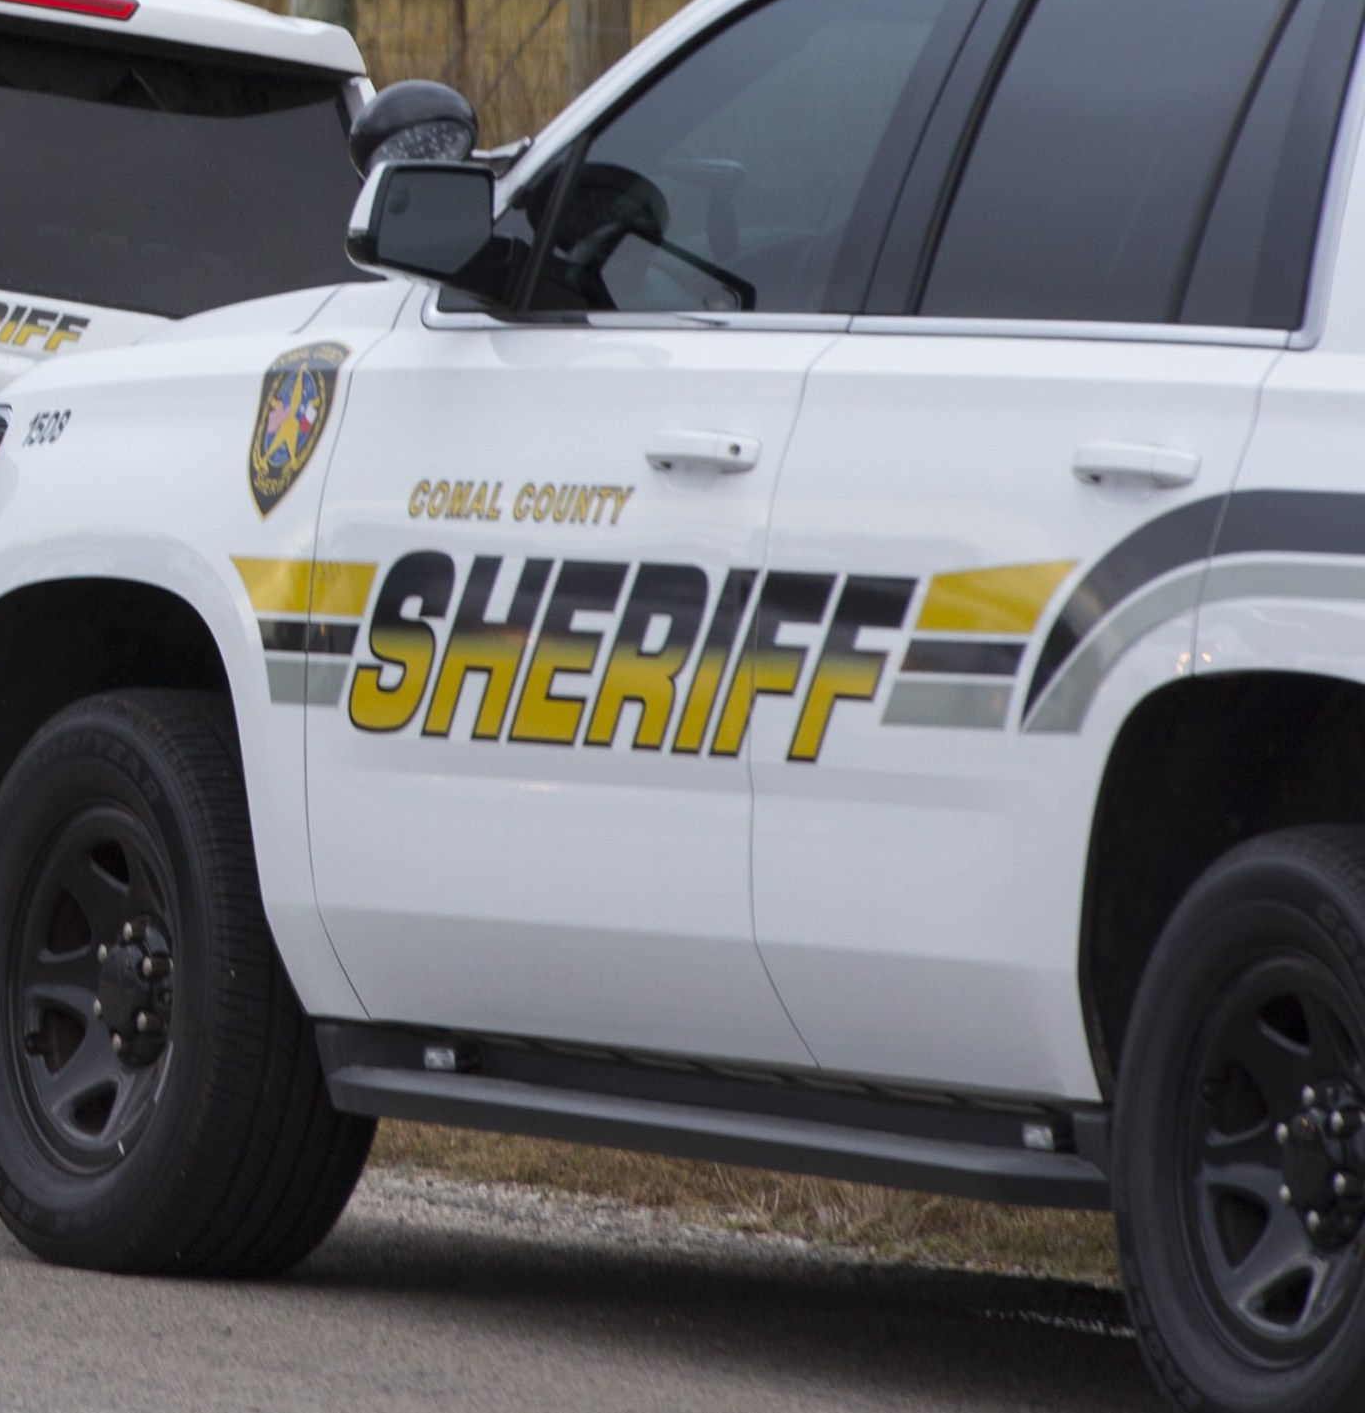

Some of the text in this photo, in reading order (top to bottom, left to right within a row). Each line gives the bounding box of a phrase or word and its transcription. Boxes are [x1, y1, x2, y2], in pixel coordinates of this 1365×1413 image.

[408, 479, 636, 525] COMAL COUNTY
[348, 549, 918, 763] SHERIFF
